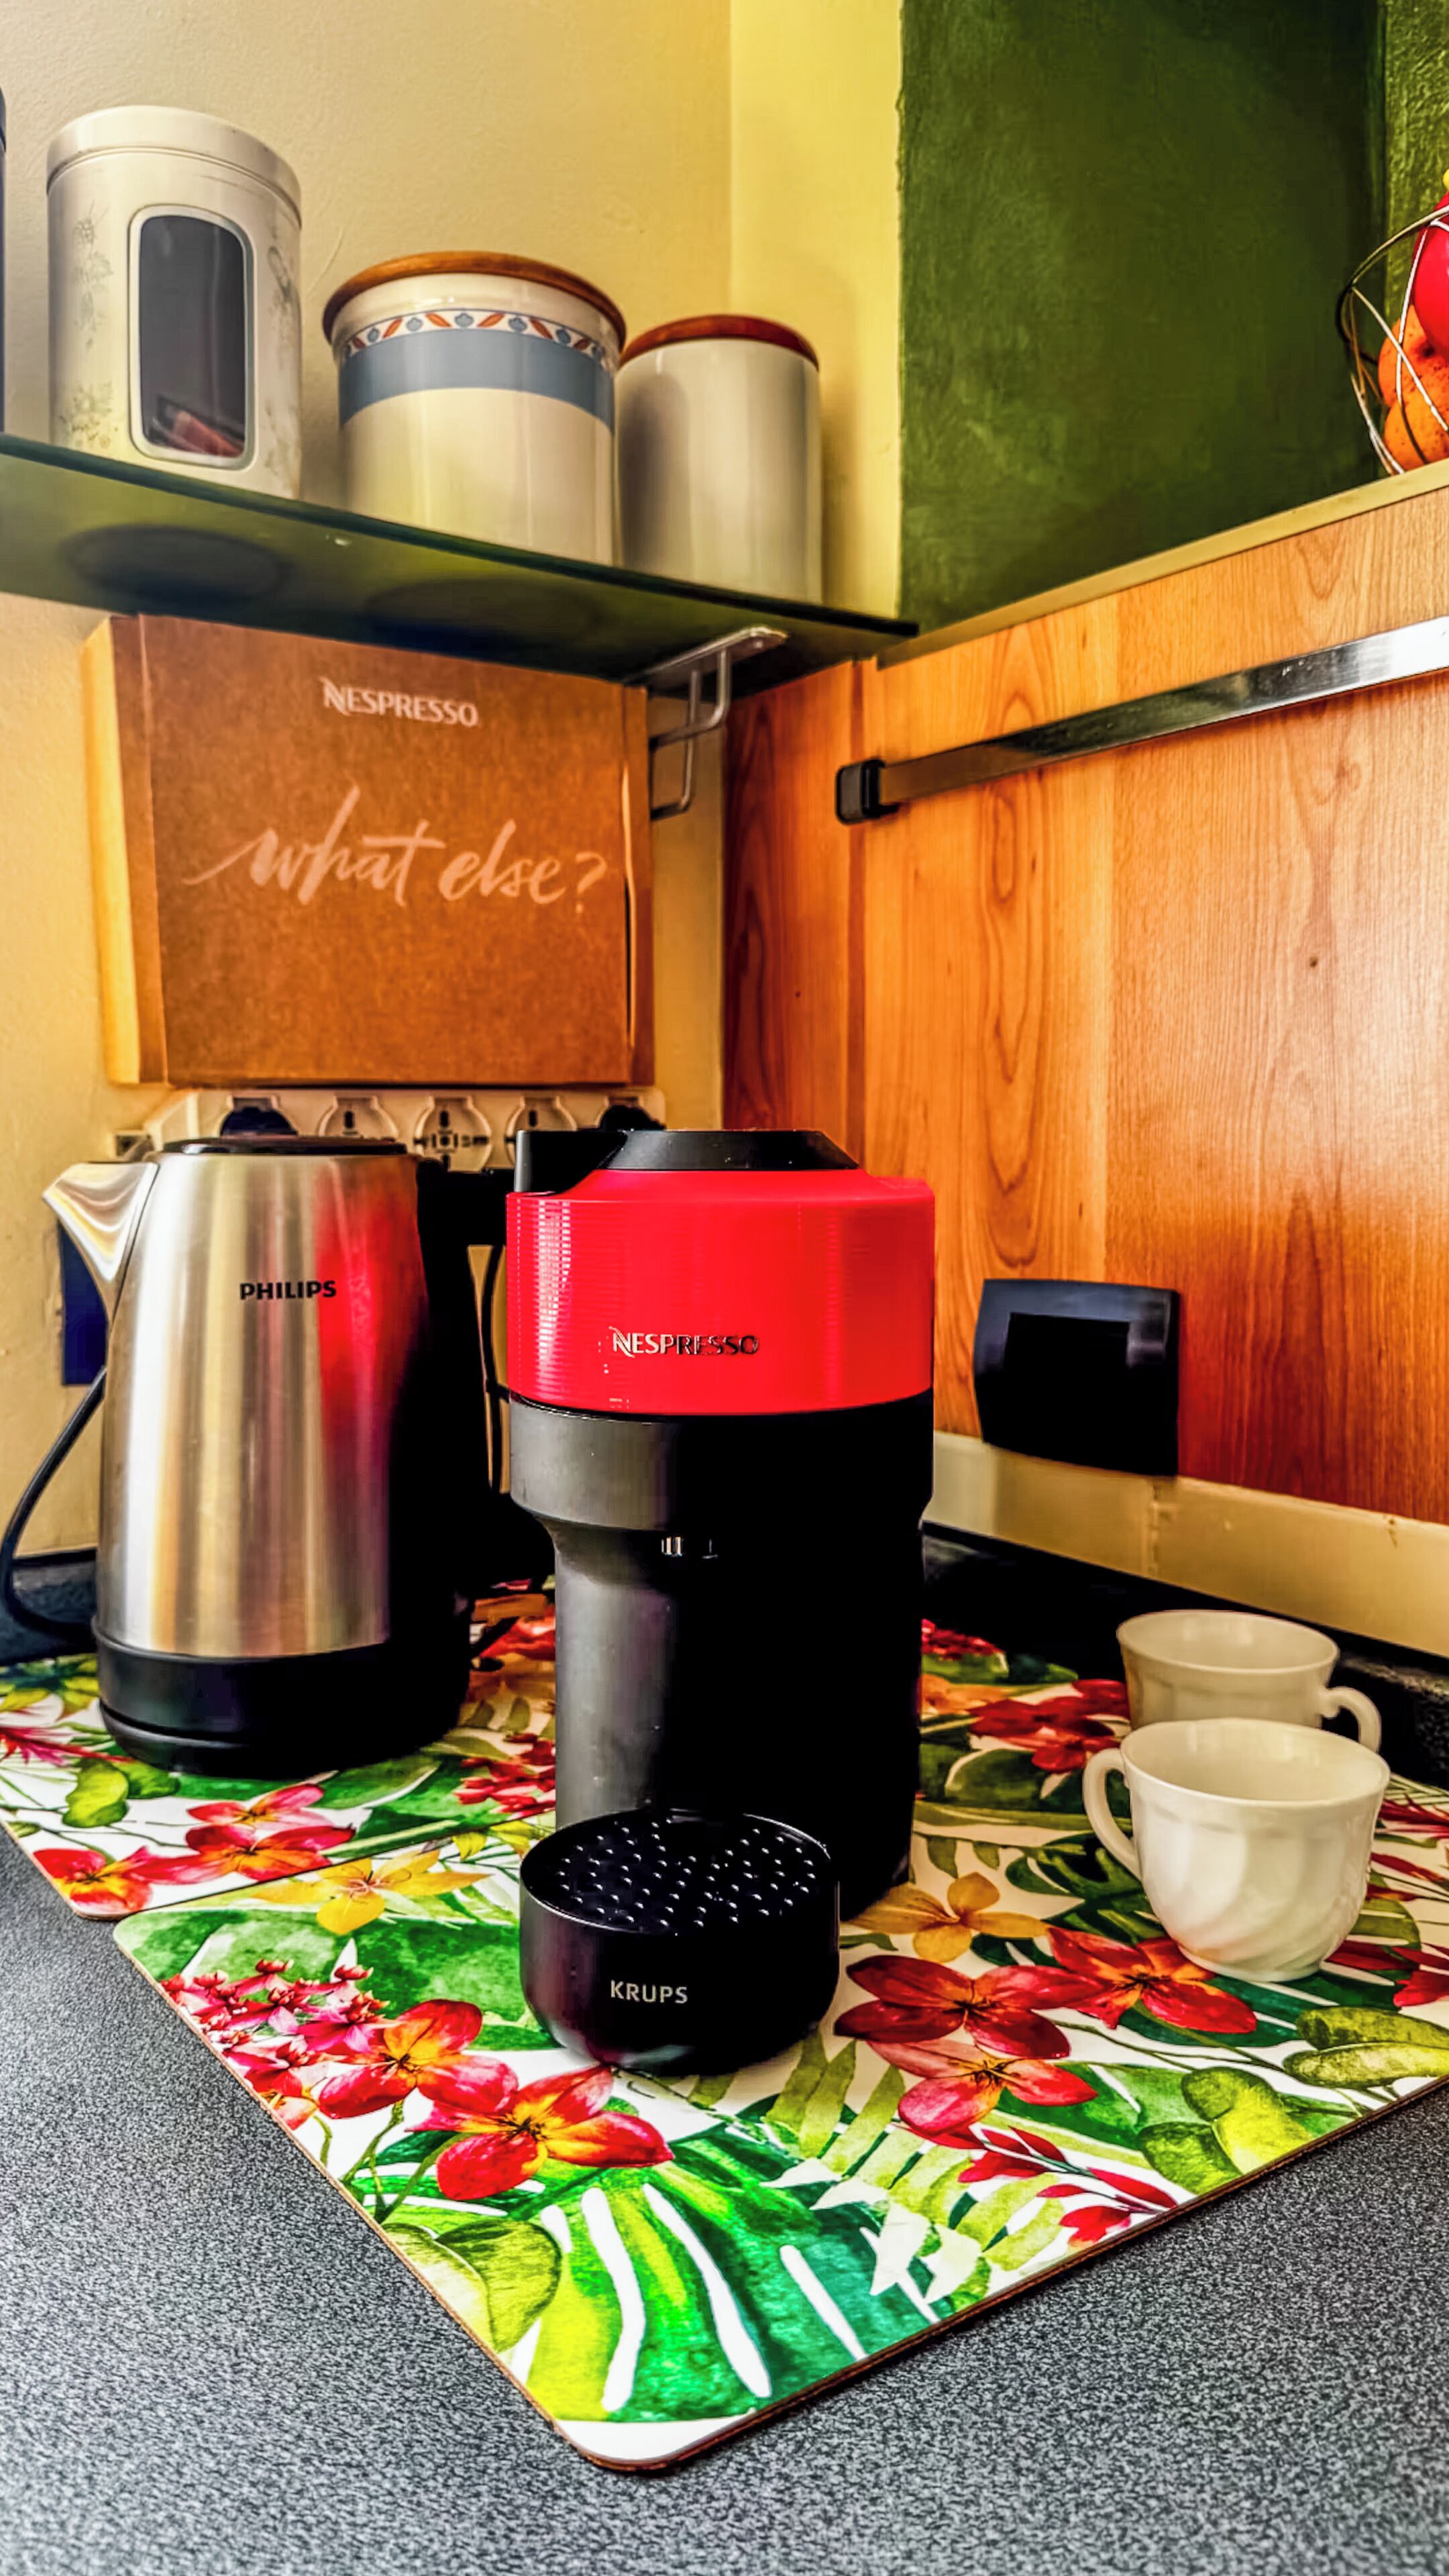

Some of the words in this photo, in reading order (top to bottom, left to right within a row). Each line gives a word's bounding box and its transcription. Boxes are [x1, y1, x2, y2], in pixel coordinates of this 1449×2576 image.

[319, 676, 479, 727] NESPRESSO
[181, 785, 446, 907] what
[439, 818, 608, 914] else?
[239, 1280, 337, 1300] PHILIPS
[608, 1326, 759, 1358] NESPRESSO
[610, 1980, 688, 2004] KRUPS
